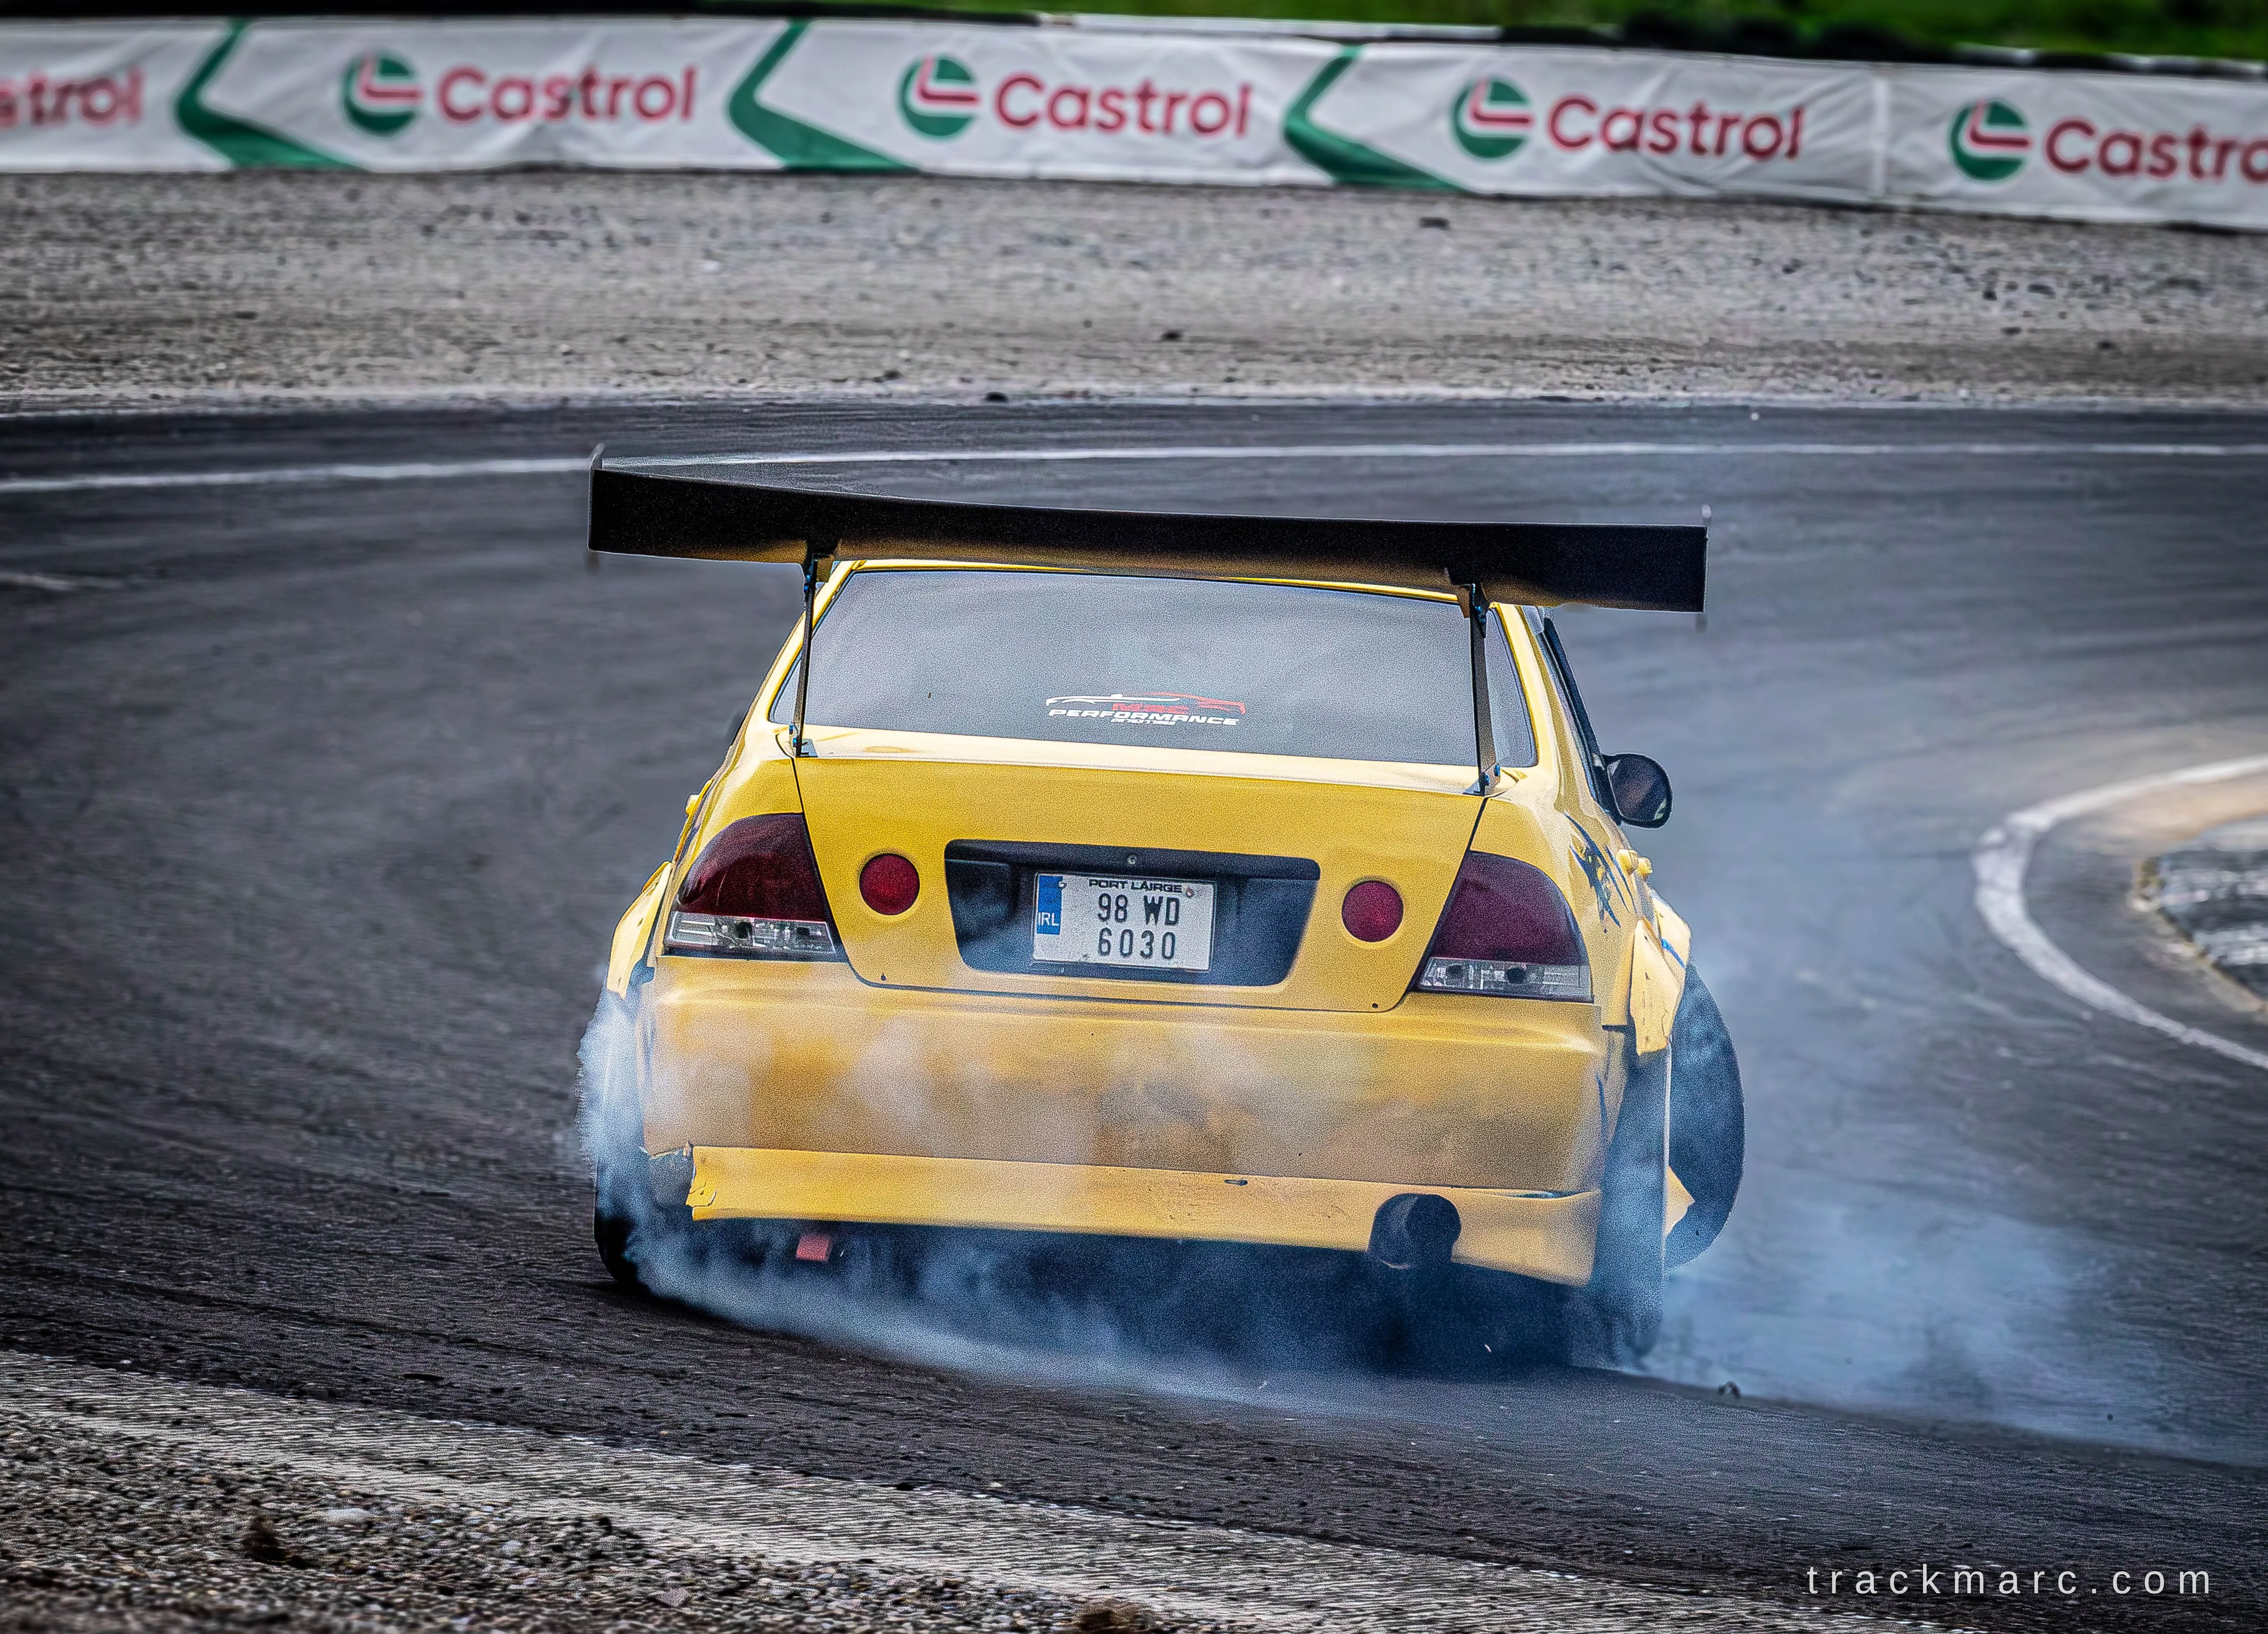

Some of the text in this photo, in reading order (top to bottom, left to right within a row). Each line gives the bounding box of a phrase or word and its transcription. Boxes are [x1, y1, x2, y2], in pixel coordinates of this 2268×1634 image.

[438, 64, 696, 122] Castrol
[996, 73, 1251, 136] Castrol
[1548, 96, 1803, 162] Castrol
[1048, 709, 1240, 726] PERFORMANCE
[1089, 879, 1128, 889] PORT
[1038, 912, 1060, 926] IRL
[1097, 893, 1180, 926] 98 WD
[1098, 927, 1176, 960] 6030
